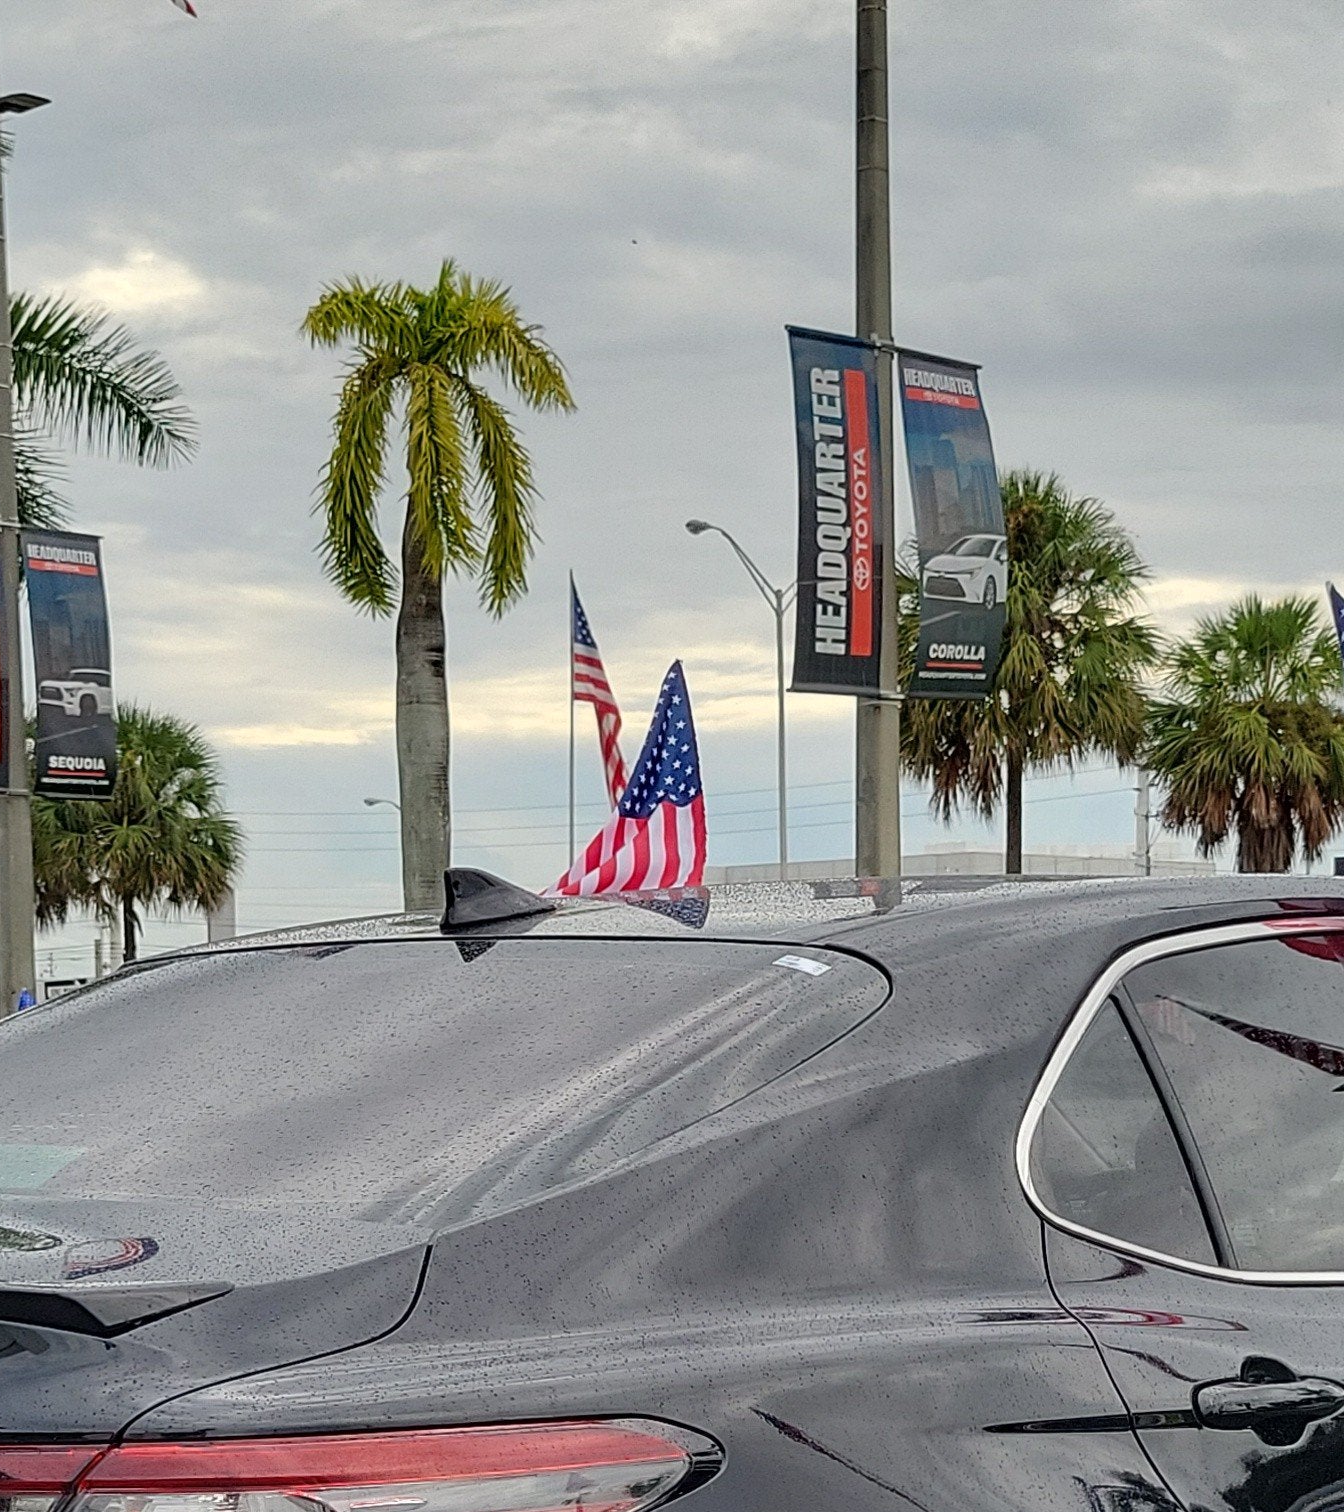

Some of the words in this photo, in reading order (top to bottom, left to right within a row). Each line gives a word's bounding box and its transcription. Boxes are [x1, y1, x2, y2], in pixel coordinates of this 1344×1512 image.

[904, 368, 976, 397] HEADQUARTER
[809, 367, 852, 656] HEADQUARTER
[853, 447, 869, 554] TOYOTA
[928, 643, 986, 661] COROLLA
[48, 755, 107, 771] SEQUOIA
